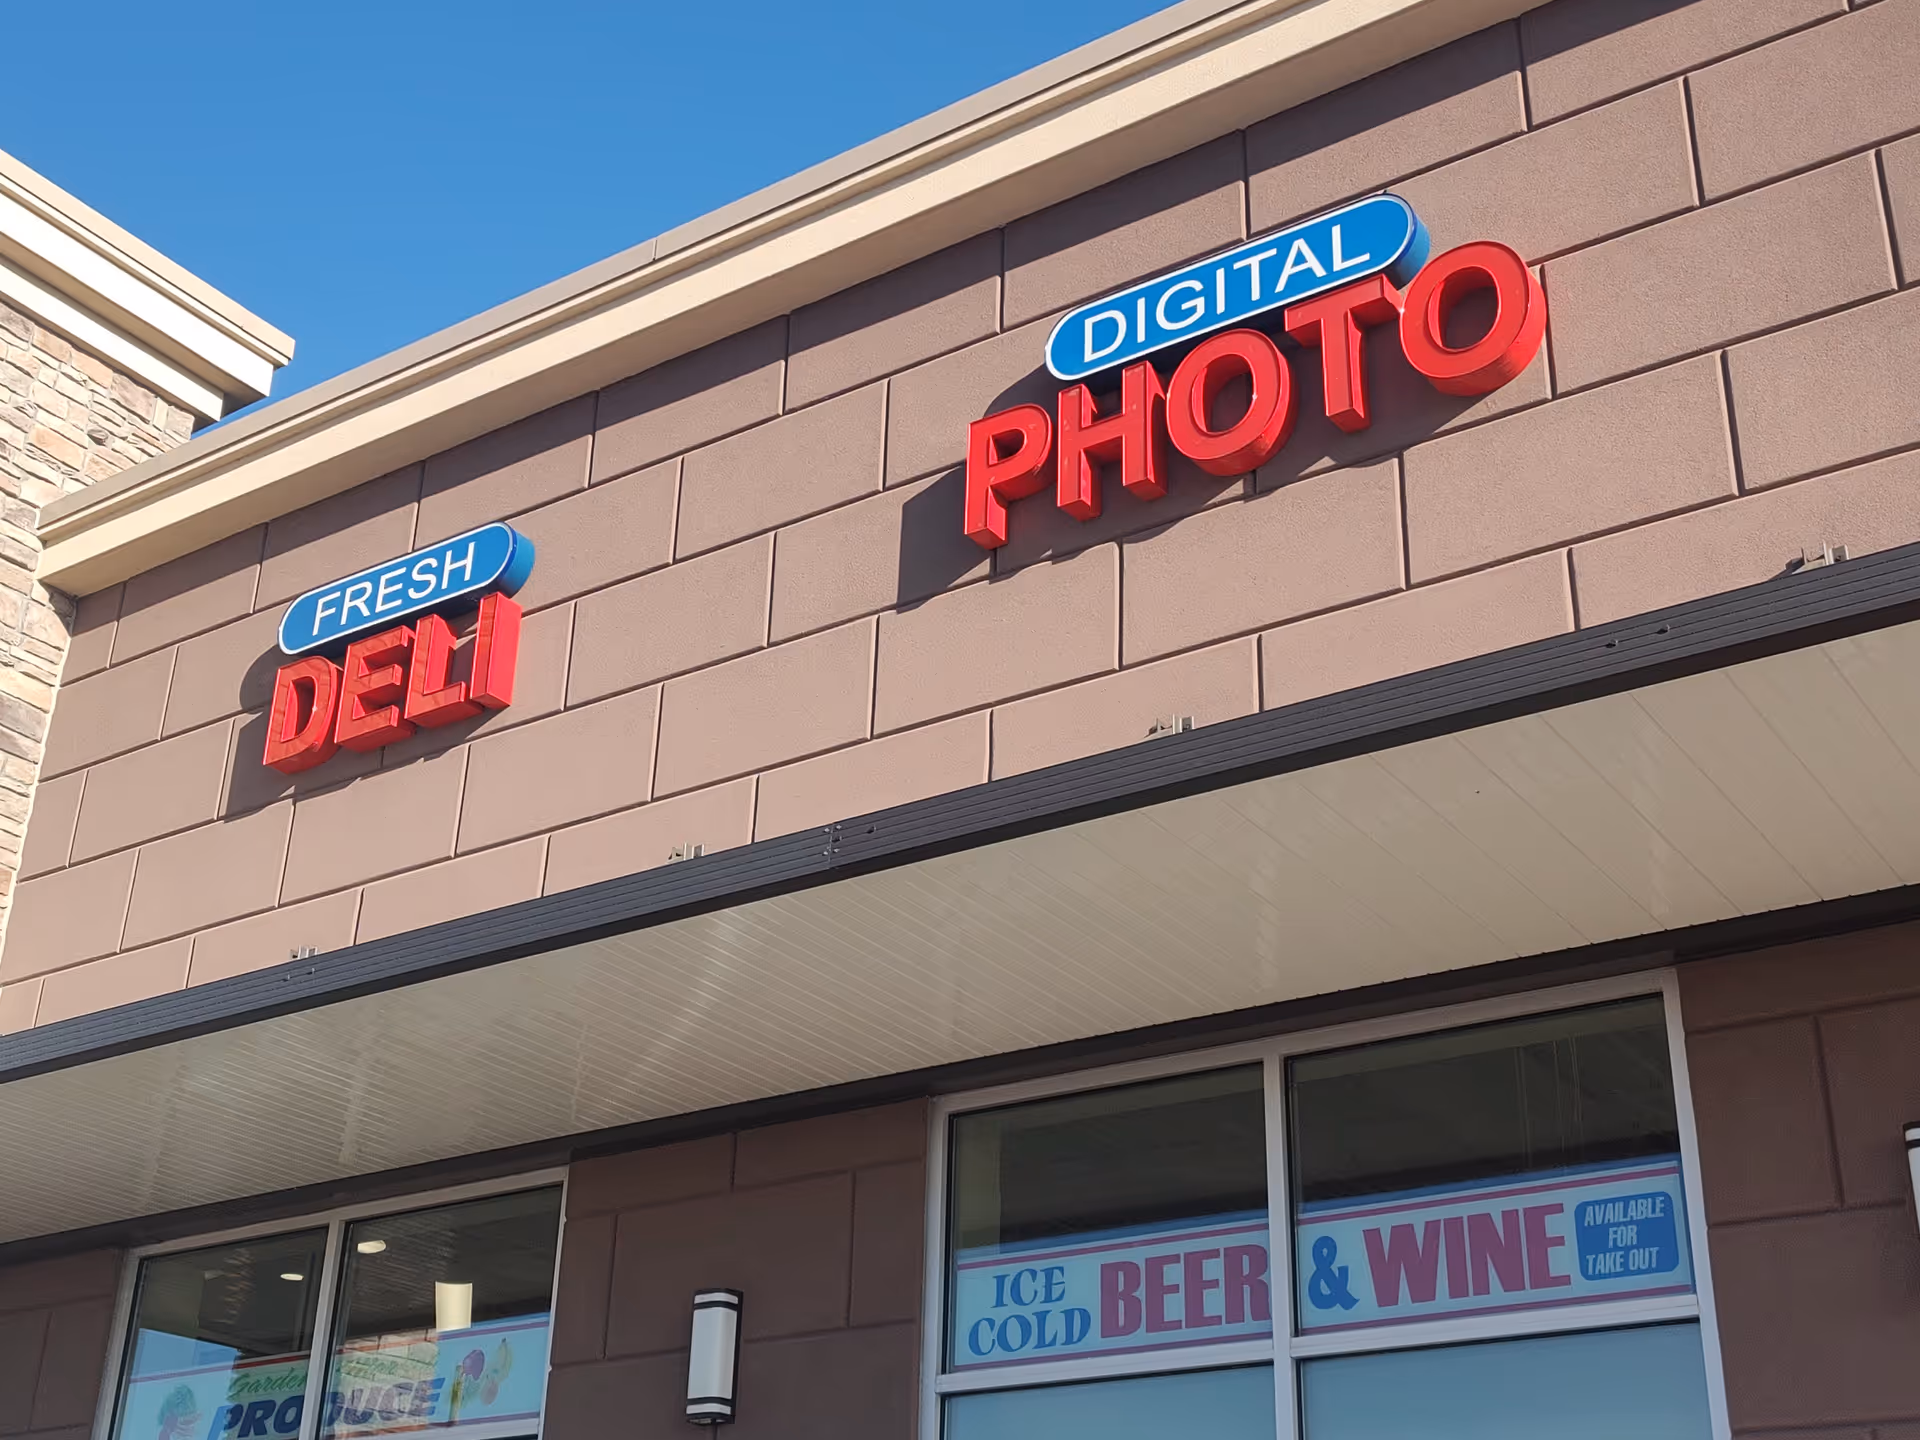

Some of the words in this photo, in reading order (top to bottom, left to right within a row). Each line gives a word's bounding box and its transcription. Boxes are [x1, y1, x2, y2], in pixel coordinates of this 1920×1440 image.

[1083, 224, 1372, 363] DIGITAL
[964, 240, 1548, 550] PHOTO
[311, 541, 476, 637] FRESH
[262, 591, 522, 774] DELI
[1583, 1196, 1665, 1227] AVAILABLE
[1607, 1225, 1638, 1249] FOR
[990, 1266, 1066, 1309] ICE
[1100, 1244, 1273, 1339] BEER
[1307, 1235, 1361, 1311] &
[1362, 1202, 1572, 1308] WINE
[1585, 1251, 1625, 1276] TAKE
[1628, 1247, 1660, 1271] OUT
[968, 1307, 1092, 1357] COLD
